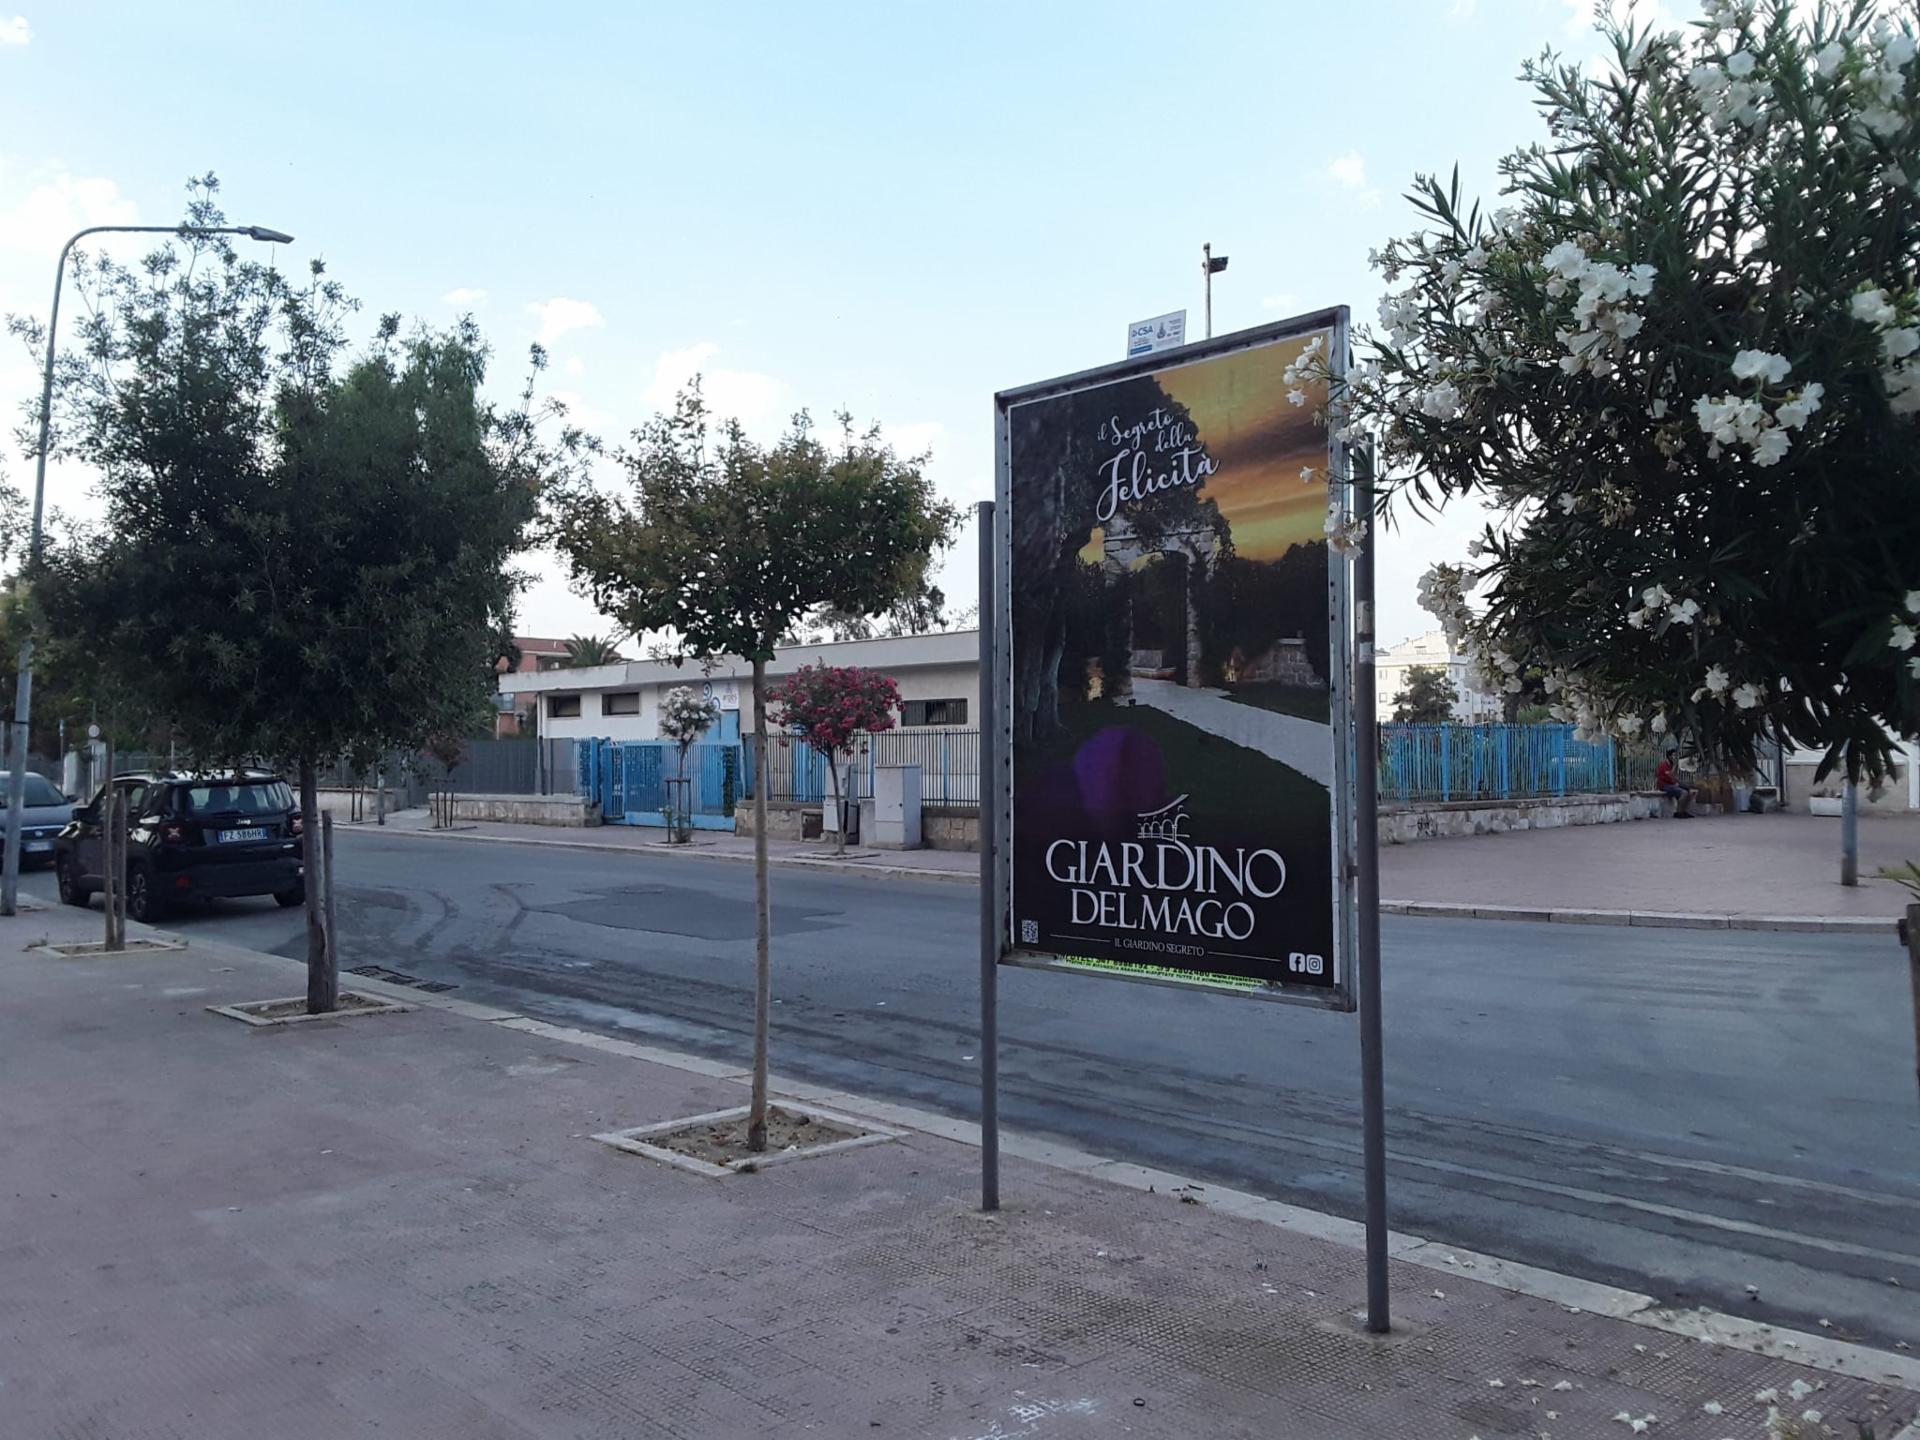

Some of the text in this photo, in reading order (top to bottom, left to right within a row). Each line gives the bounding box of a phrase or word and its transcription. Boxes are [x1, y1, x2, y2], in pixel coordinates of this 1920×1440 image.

[1138, 325, 1153, 336] CSA
[1097, 408, 1173, 450] il Segreto
[1155, 422, 1193, 452] della
[1096, 444, 1220, 521] Felicità
[1046, 839, 1286, 898] GIARDINO
[1114, 938, 1204, 957] IL GIARDINO SEGRETO
